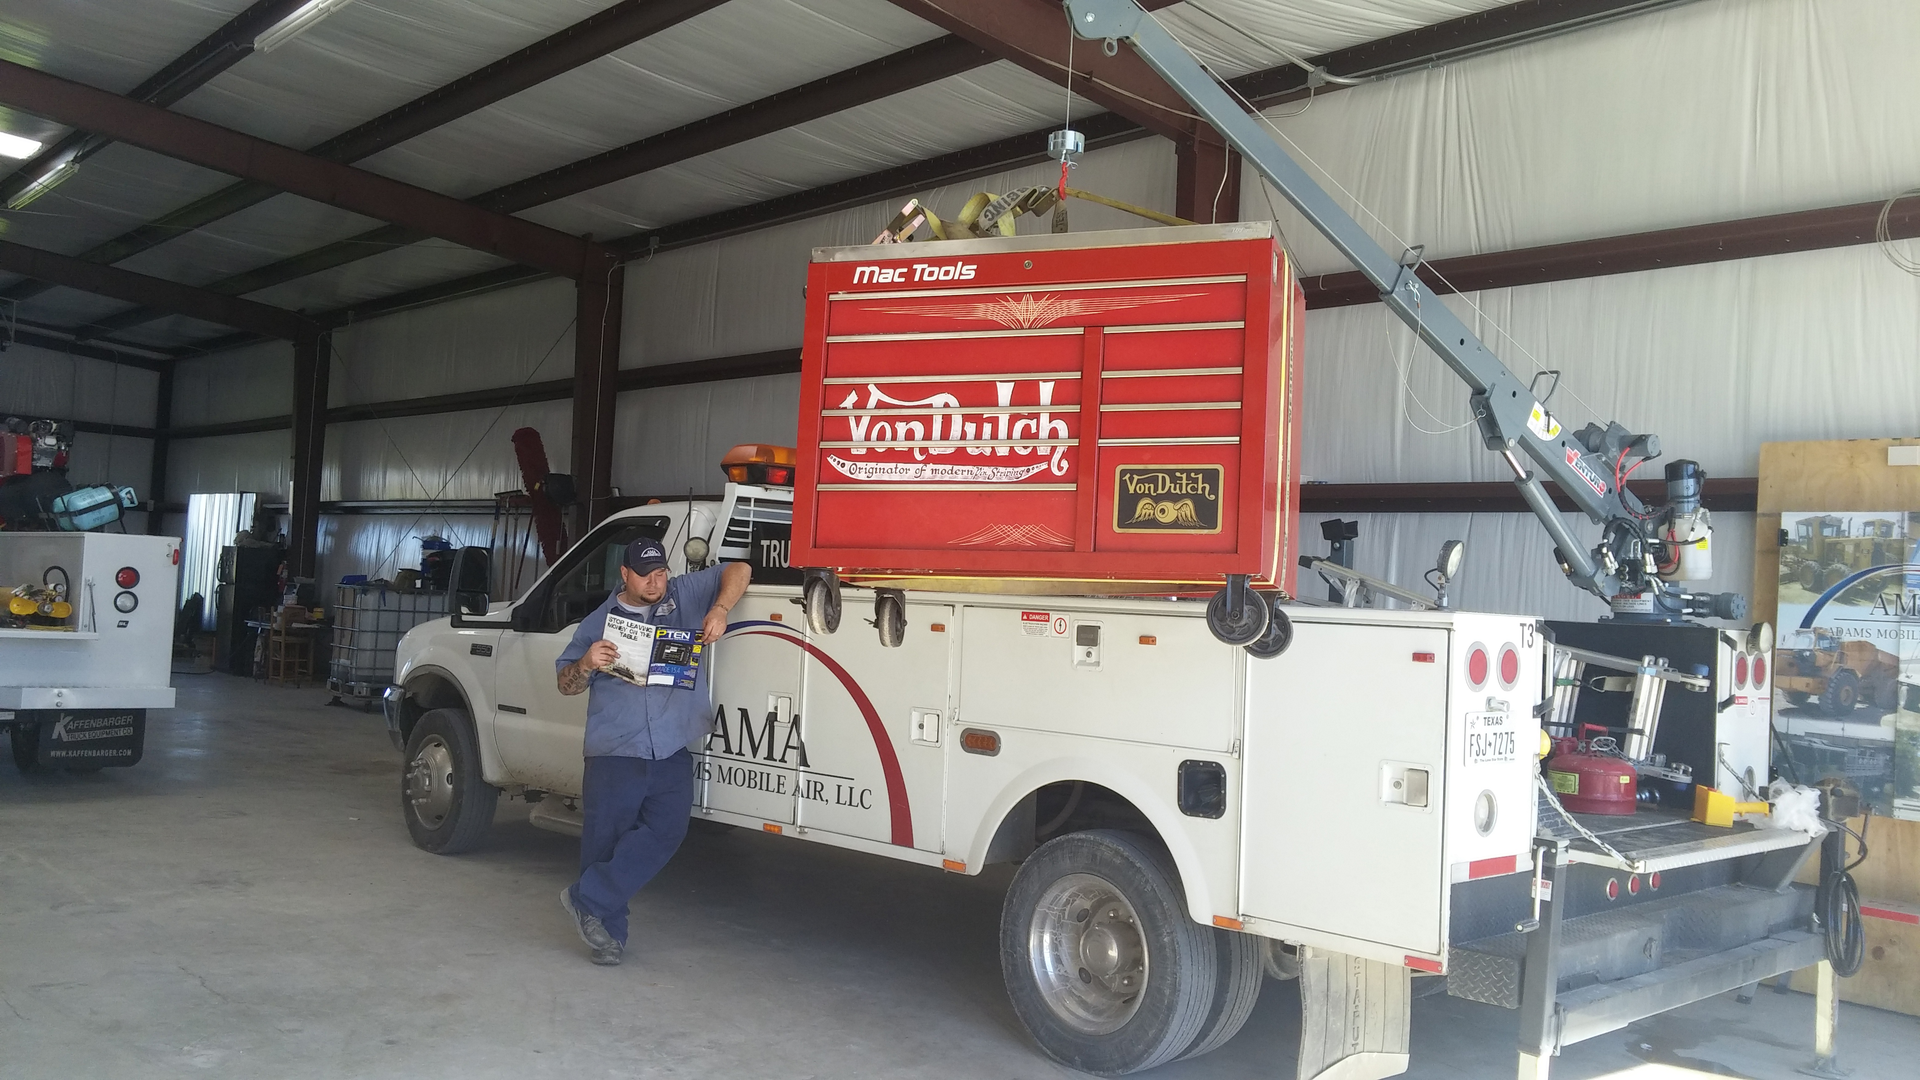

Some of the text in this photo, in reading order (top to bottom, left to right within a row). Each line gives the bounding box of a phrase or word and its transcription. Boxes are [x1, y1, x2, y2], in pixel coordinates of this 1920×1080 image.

[852, 261, 977, 284] Mac Tools
[848, 462, 911, 478] Originator
[914, 463, 927, 478] of
[930, 466, 973, 477] modern
[987, 466, 1024, 480] Striping
[607, 622, 628, 632] MONEY
[608, 616, 653, 633] STOP LEAVING
[620, 631, 638, 641] TABLE
[656, 629, 691, 640] PTEN
[1520, 623, 1534, 648] T3
[1828, 627, 1920, 640] ADAMS MOBIL
[51, 713, 134, 742] KAFFENBARGER
[1483, 716, 1503, 726] TEXAS
[67, 732, 87, 741] TRUCK
[87, 729, 121, 739] EQUIPMENT
[705, 703, 811, 769] AMA
[50, 749, 132, 758] WWW.KAFFENBARGER.COM
[716, 764, 787, 795] MOBILE
[791, 779, 829, 805] AIR,
[835, 784, 872, 810] LLC
